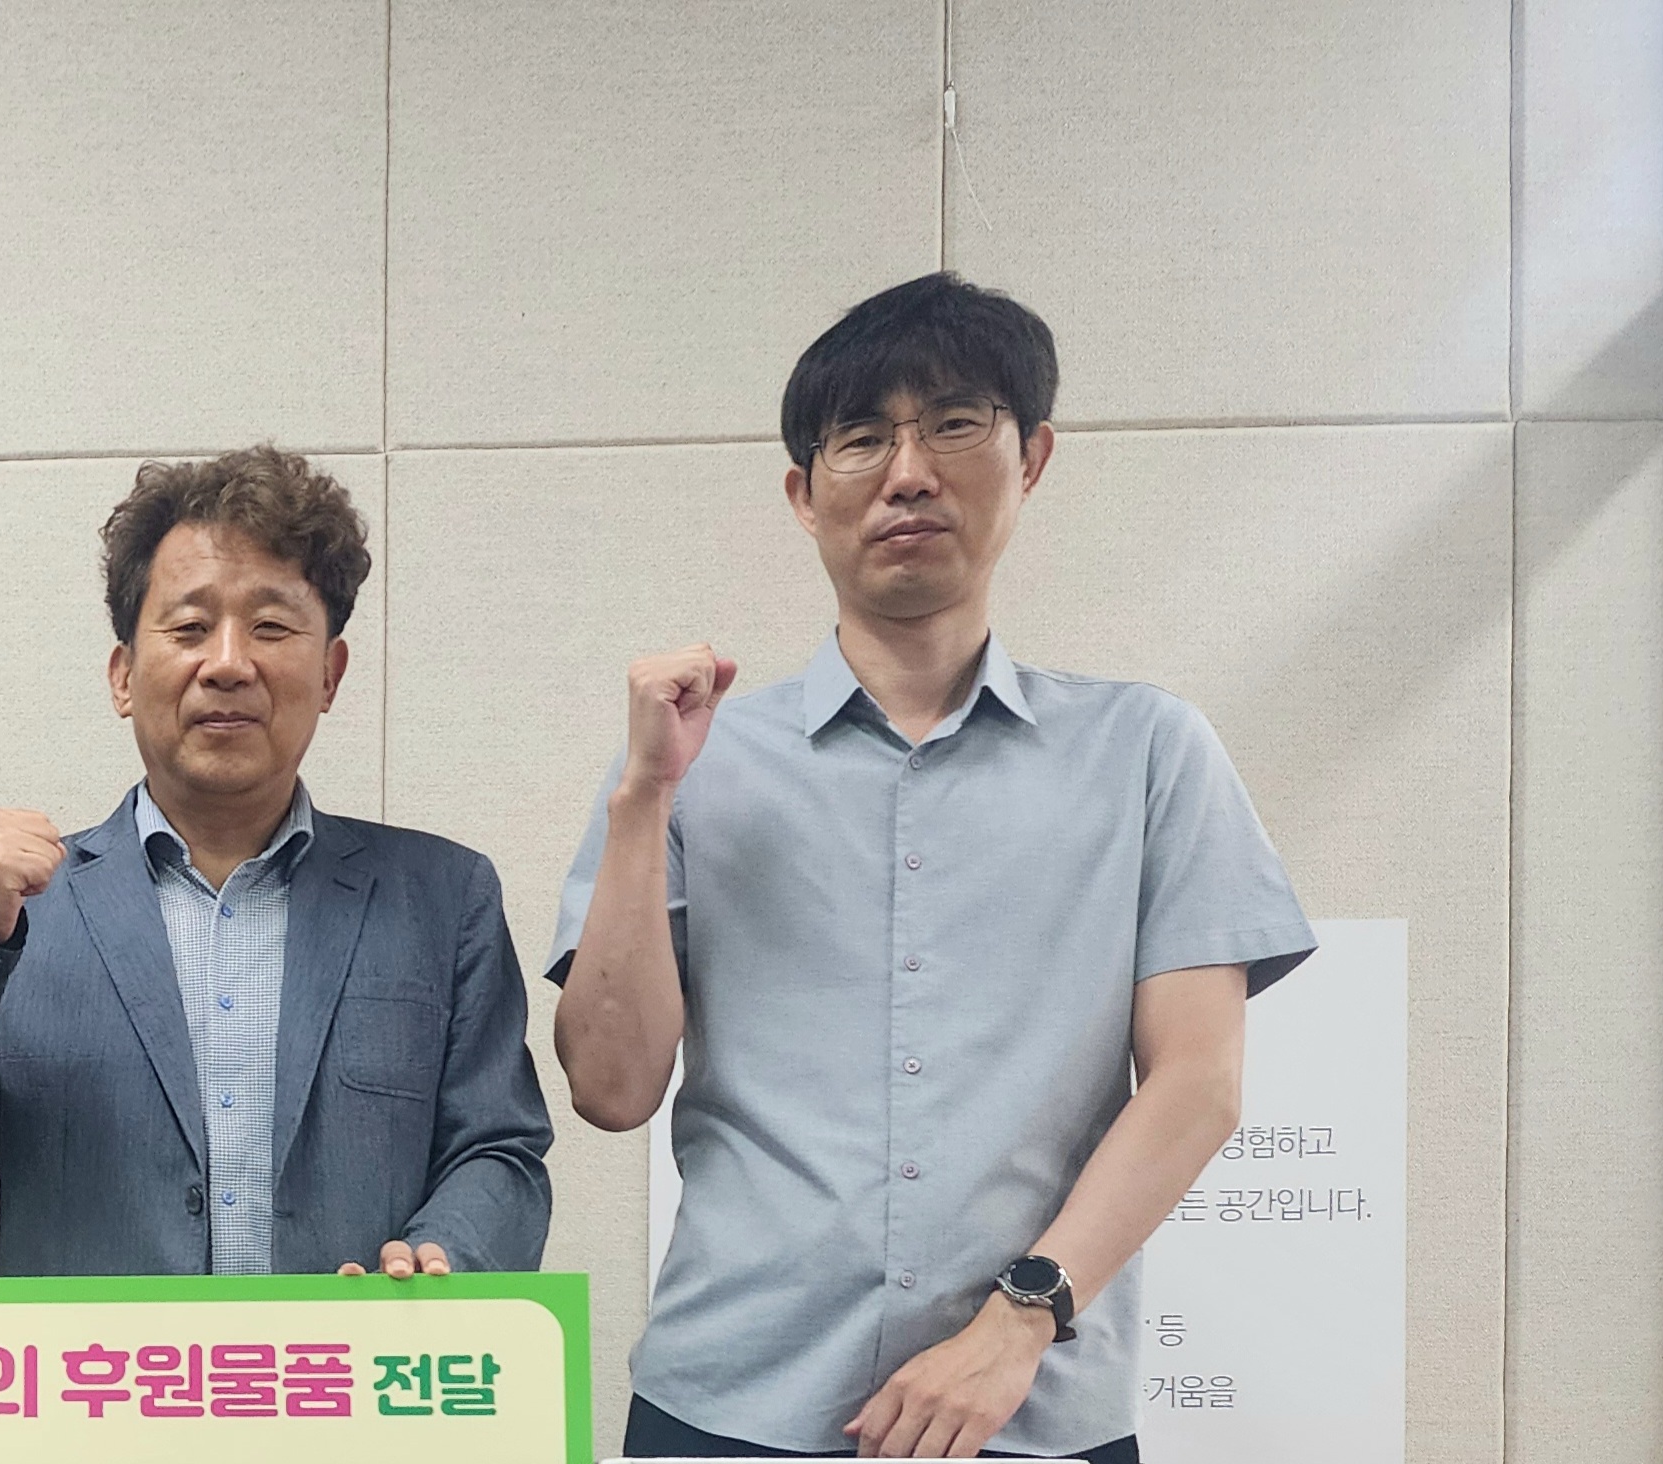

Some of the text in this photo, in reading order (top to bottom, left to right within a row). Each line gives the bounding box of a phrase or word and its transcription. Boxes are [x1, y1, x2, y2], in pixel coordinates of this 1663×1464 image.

[1163, 1188, 1372, 1223] 든 공간입니다.
[1155, 1314, 1187, 1347] 등
[61, 1342, 353, 1418] 후원물품
[372, 1351, 499, 1418] 전달
[1143, 1374, 1237, 1409] 거움을
